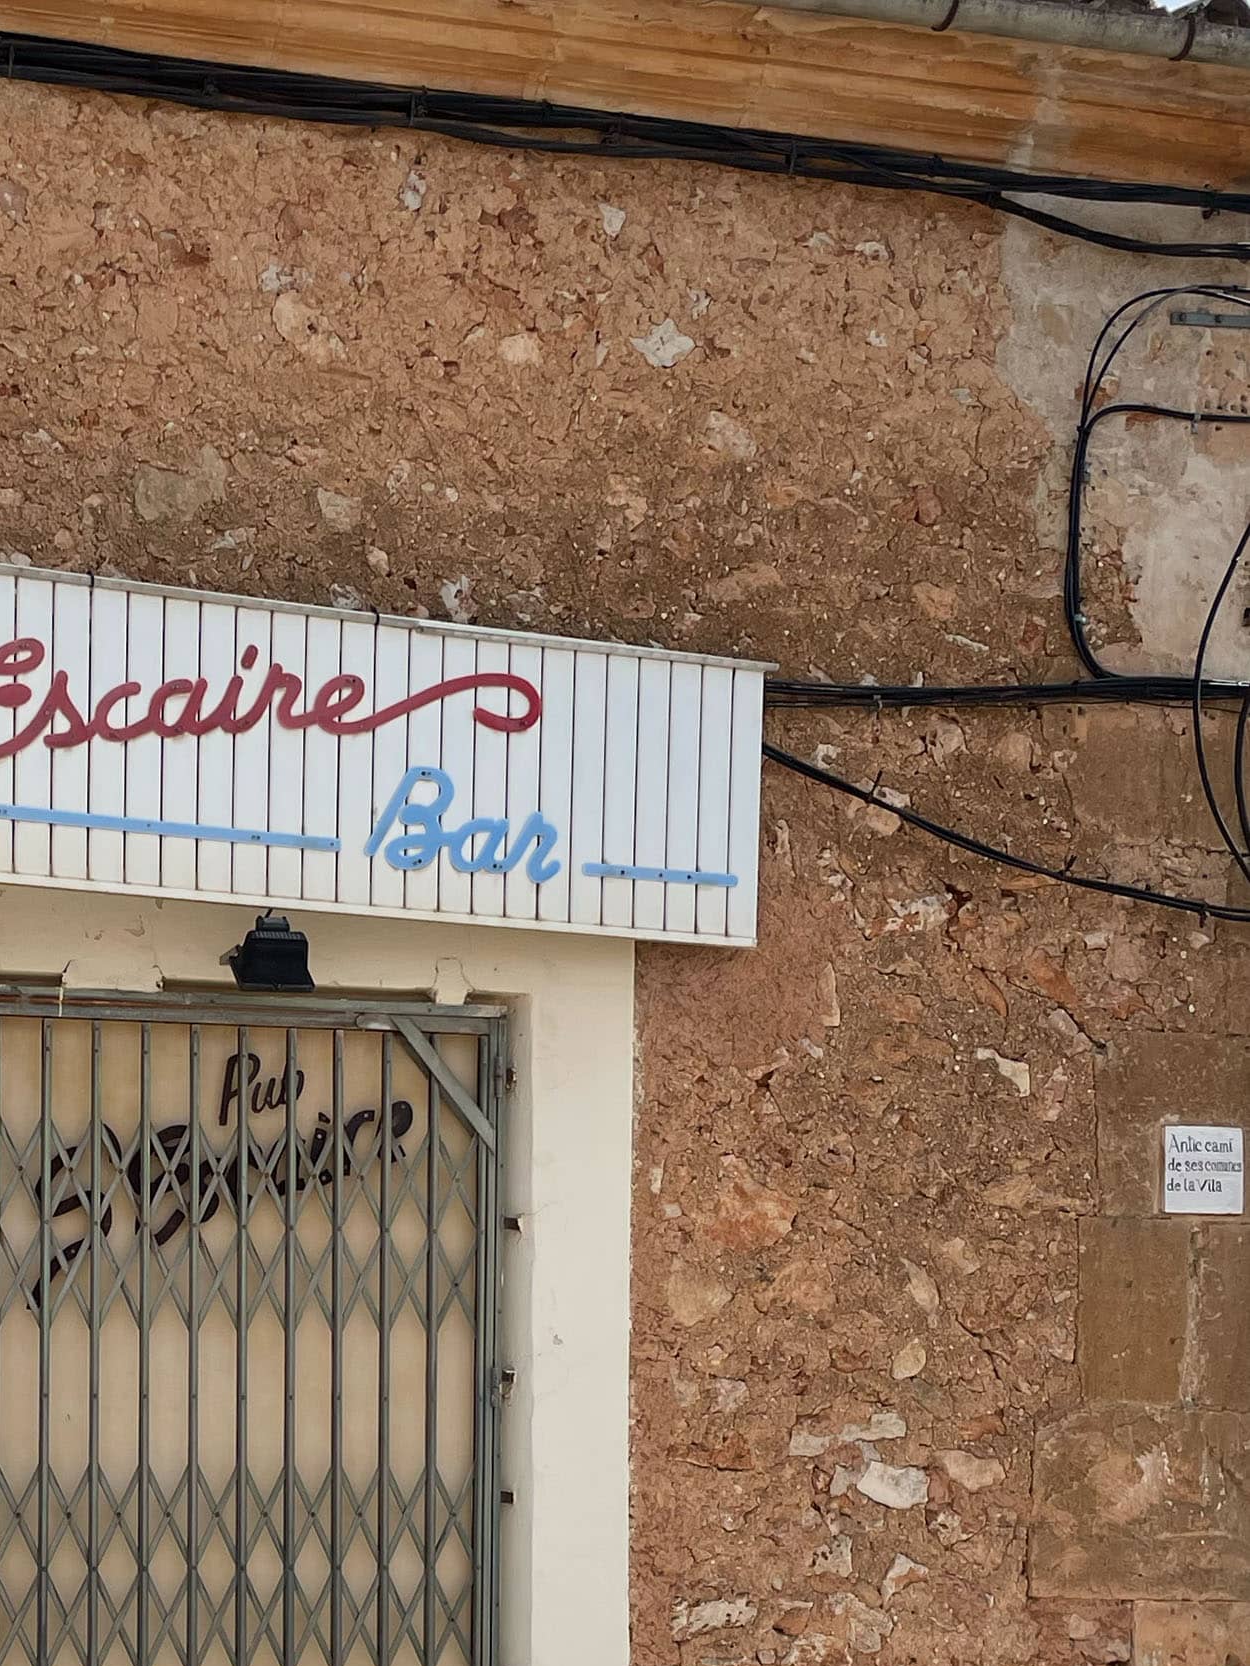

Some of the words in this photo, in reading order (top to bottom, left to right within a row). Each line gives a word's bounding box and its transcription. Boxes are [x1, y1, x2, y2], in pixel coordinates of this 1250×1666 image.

[364, 766, 562, 885] Bar
[219, 1052, 305, 1126] Pub
[1166, 1178, 1182, 1192] de
[1183, 1178, 1196, 1192] la
[1196, 1178, 1223, 1193] Vila
[1167, 1157, 1182, 1172] de
[1184, 1160, 1204, 1172] ses
